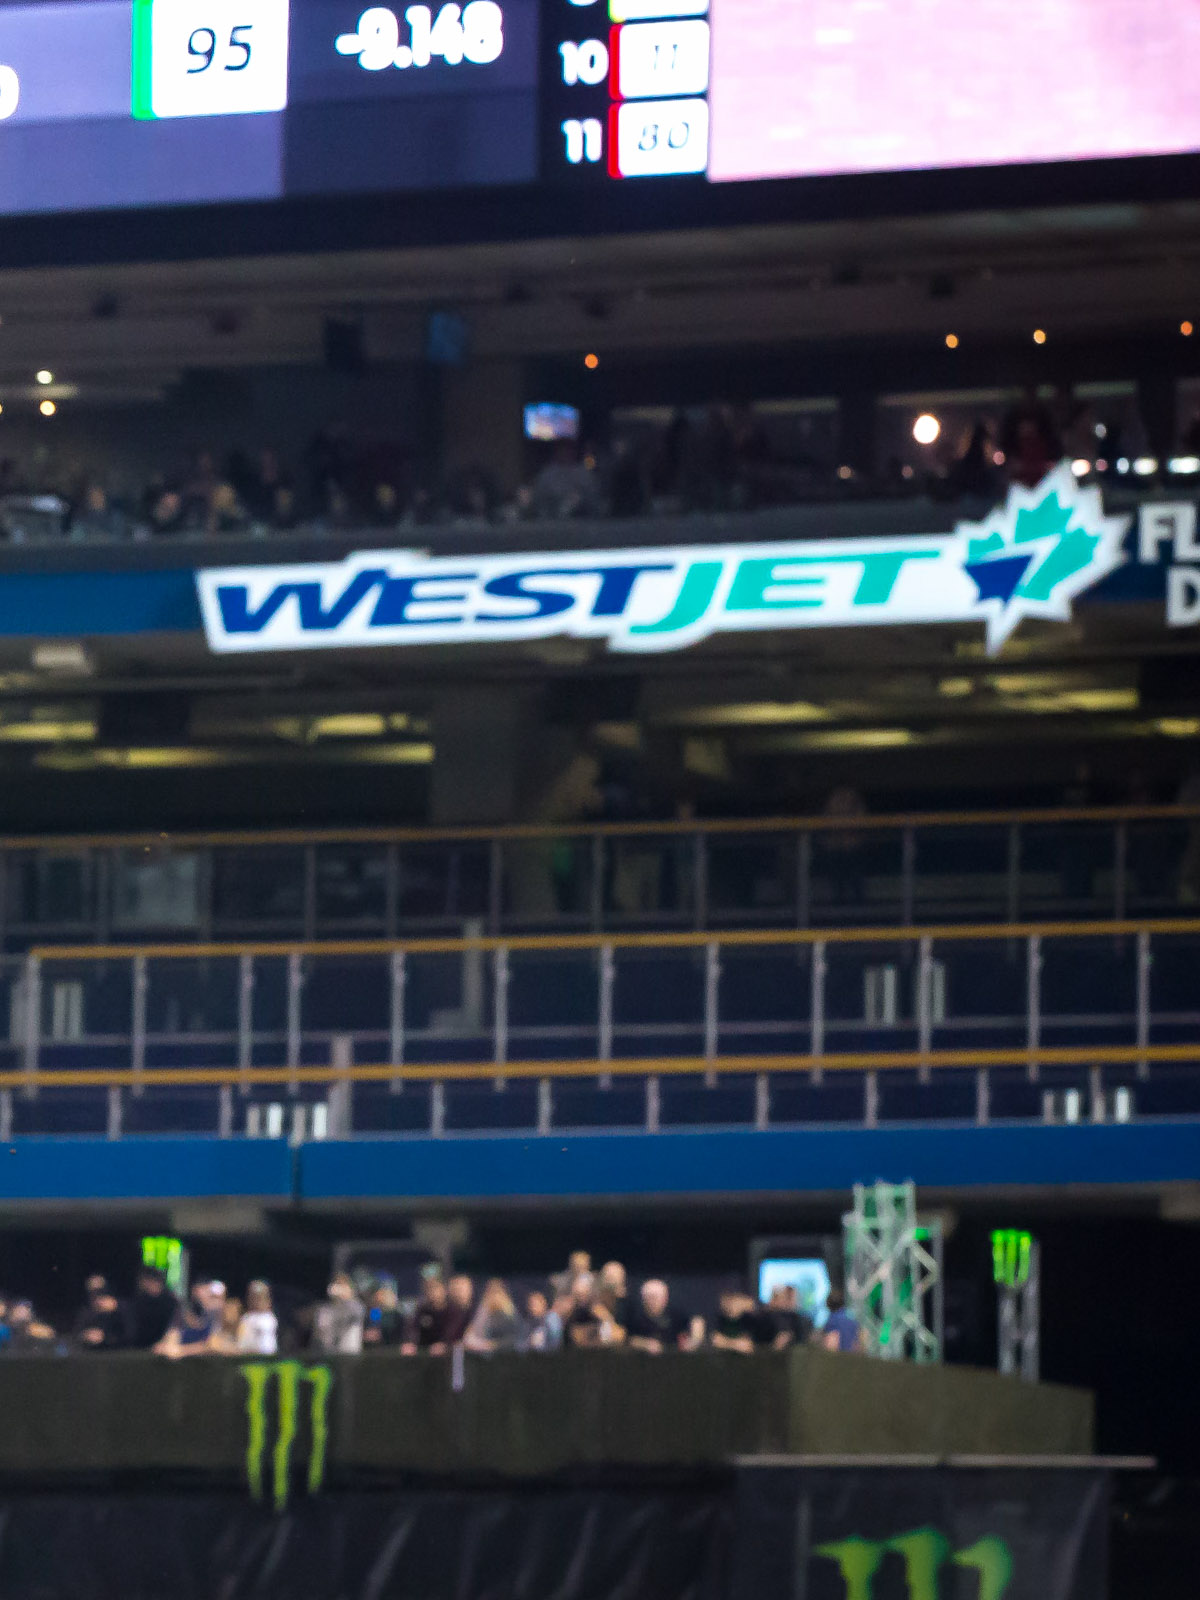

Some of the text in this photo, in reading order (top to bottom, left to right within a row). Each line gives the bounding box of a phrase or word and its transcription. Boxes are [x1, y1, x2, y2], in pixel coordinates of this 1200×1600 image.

[185, 25, 255, 74] 95
[336, 1, 504, 72] -9.148
[558, 38, 608, 86] 10
[561, 118, 602, 163] 11
[215, 550, 941, 635] WESTJET
